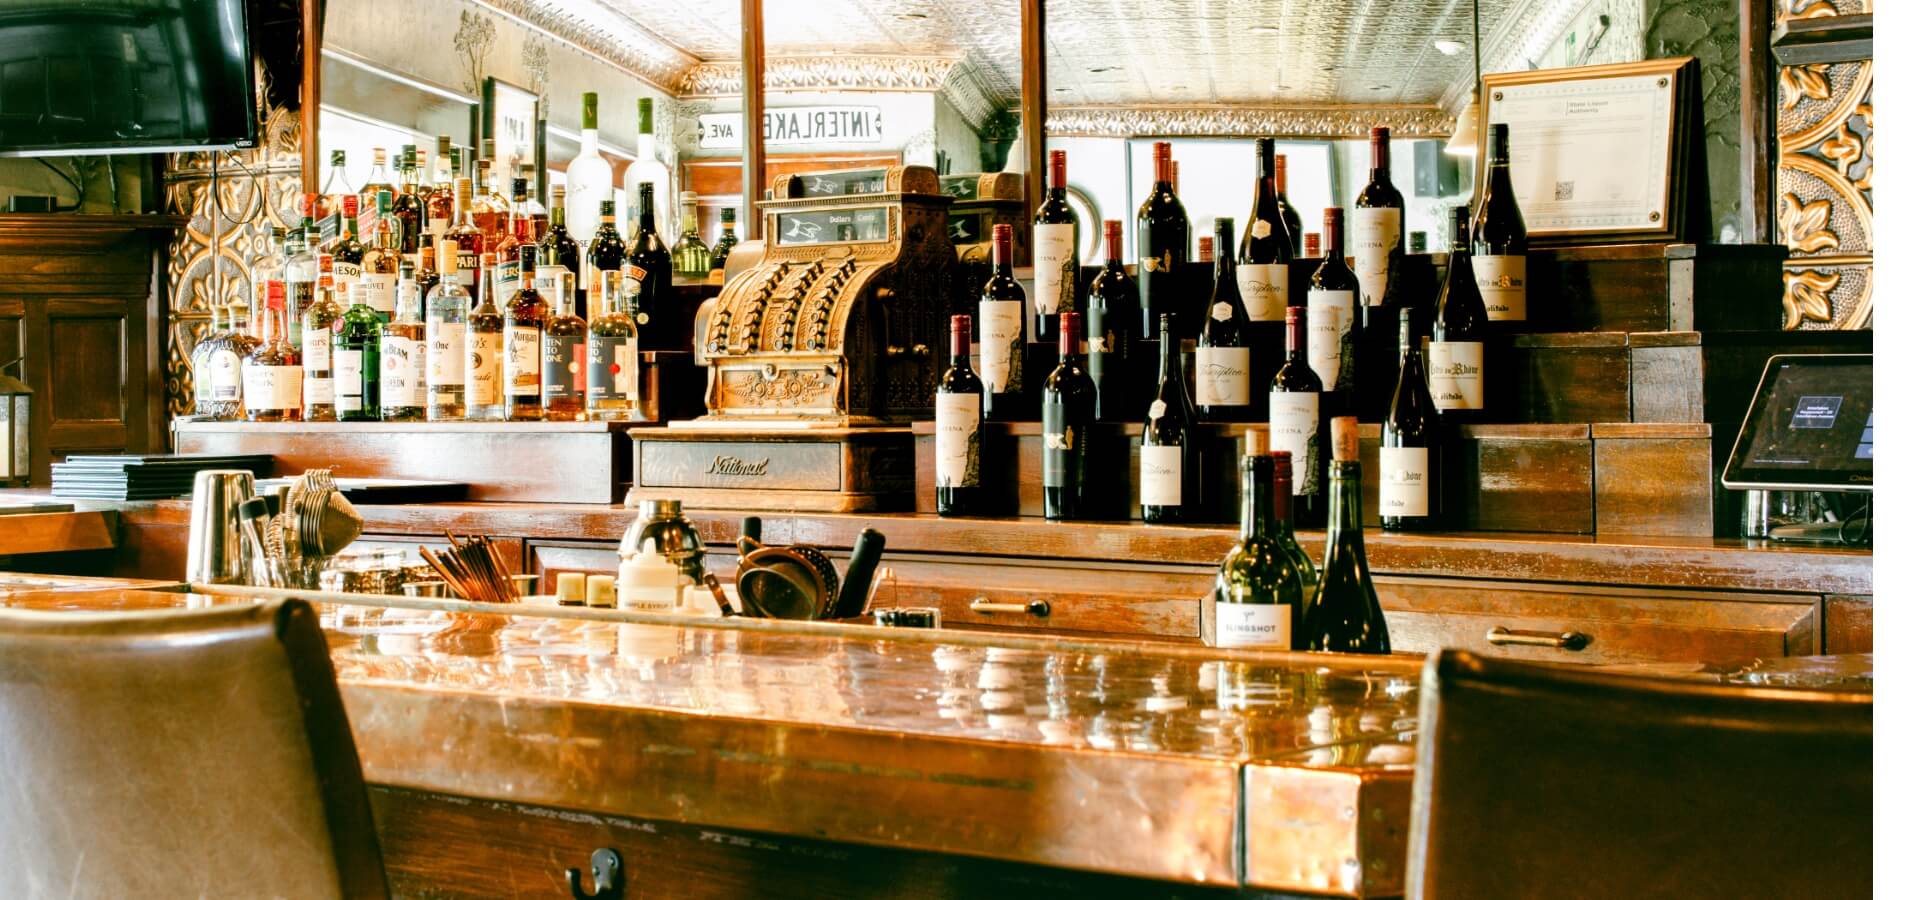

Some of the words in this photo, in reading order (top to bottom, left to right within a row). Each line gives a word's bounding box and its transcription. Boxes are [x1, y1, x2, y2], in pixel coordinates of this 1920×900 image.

[829, 215, 851, 223] Dollars
[514, 330, 537, 343] Morgan
[547, 338, 562, 347] TEN
[546, 355, 563, 363] ONE
[705, 456, 769, 475] National
[1225, 624, 1276, 633] SLINGSHOT
